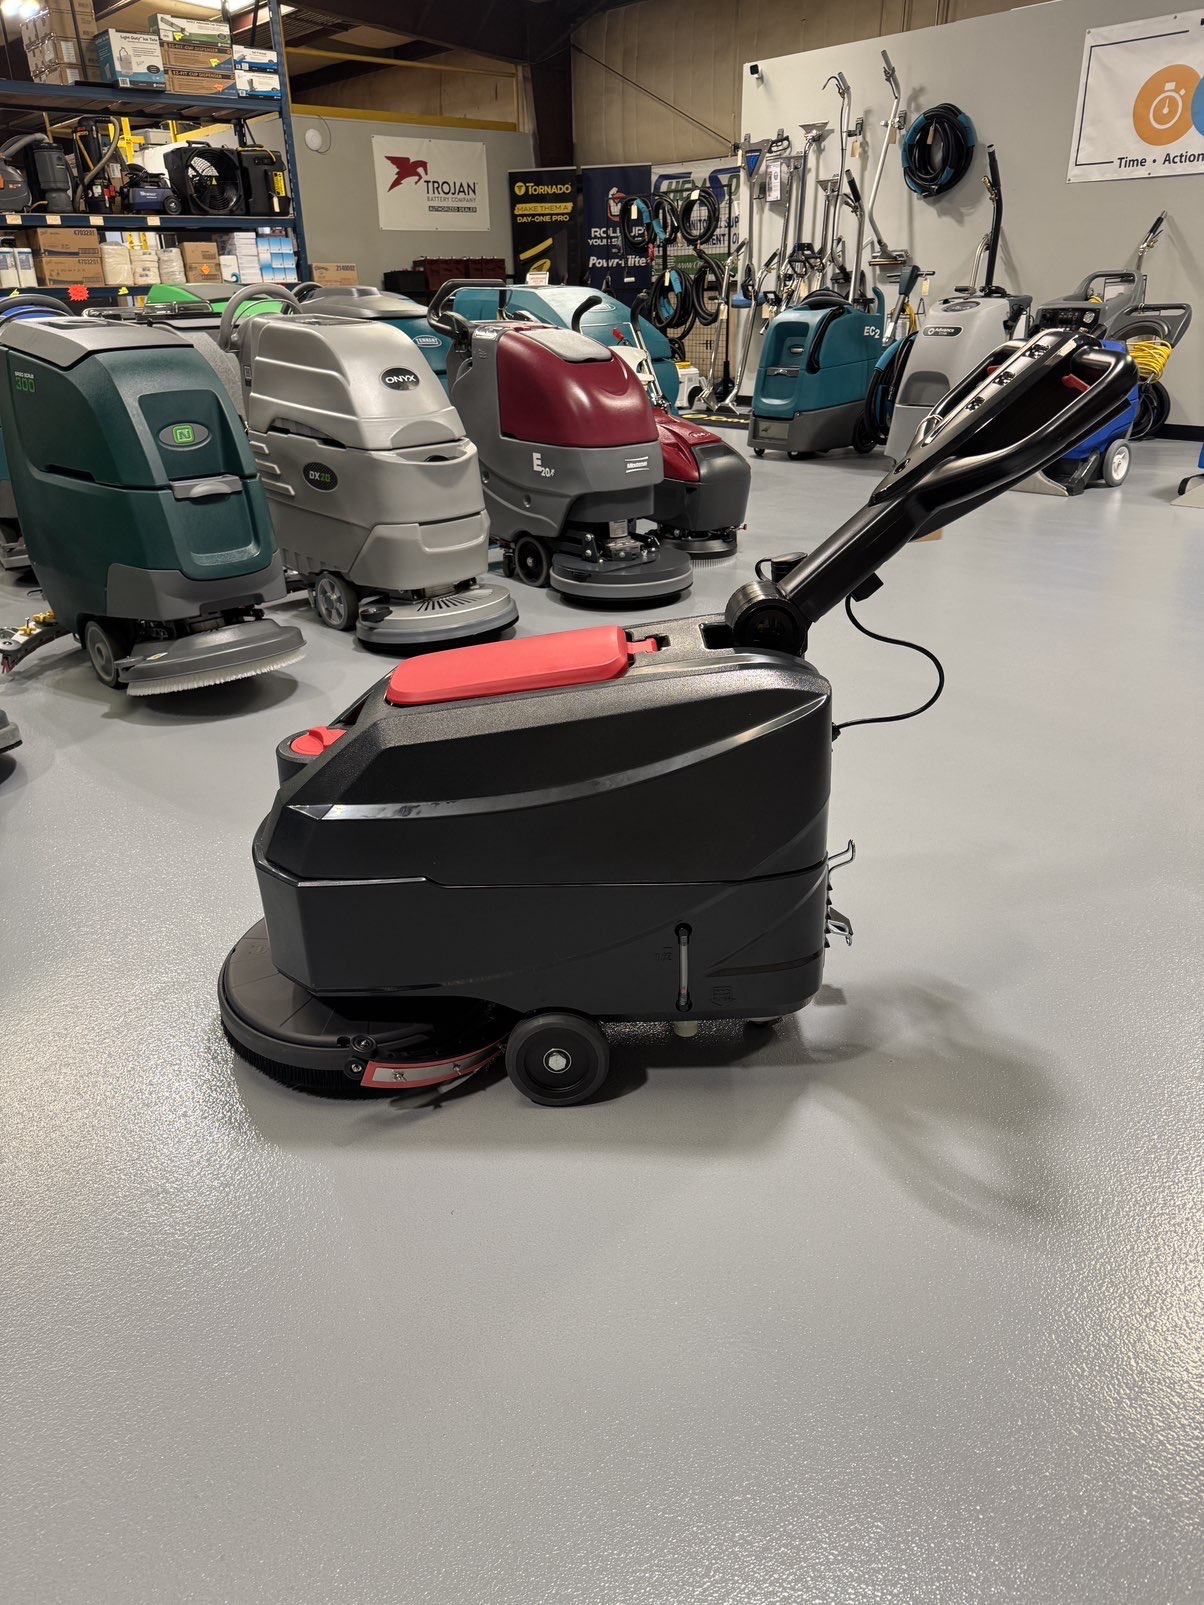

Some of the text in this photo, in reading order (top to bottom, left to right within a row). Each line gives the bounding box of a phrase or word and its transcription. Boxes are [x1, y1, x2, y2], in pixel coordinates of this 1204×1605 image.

[1117, 156, 1147, 169] Time
[424, 180, 477, 196] TROJAN
[526, 183, 572, 195] TORNADO
[516, 205, 539, 213] MAKE
[540, 204, 561, 212] THEM
[863, 326, 881, 339] EC2
[15, 376, 36, 393] 300
[385, 374, 417, 384] ONYX
[626, 461, 648, 469] Minuteman
[309, 470, 331, 482] DX20
